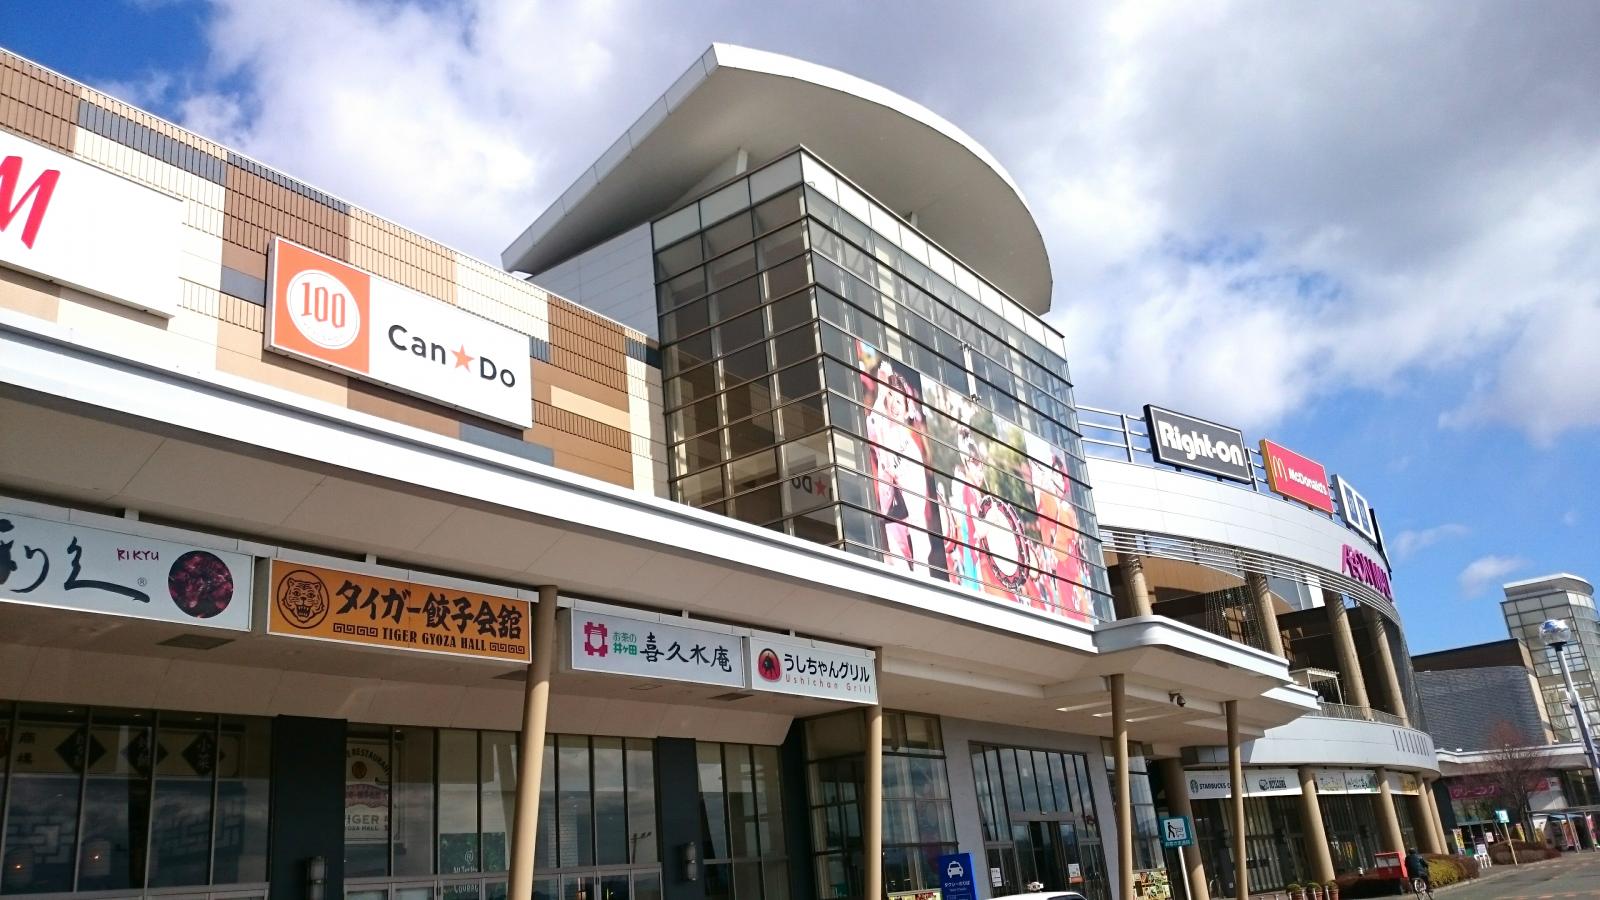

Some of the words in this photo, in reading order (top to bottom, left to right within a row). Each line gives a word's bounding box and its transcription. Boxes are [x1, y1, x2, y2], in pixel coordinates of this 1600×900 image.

[300, 282, 346, 329] 100
[388, 324, 447, 365] Can
[479, 356, 516, 388] Do
[1157, 420, 1244, 466] Right-on
[1288, 467, 1329, 496] McDonald's
[116, 547, 160, 561] RIKYU
[382, 627, 418, 644] TIGER
[421, 632, 457, 648] GYOZA
[460, 637, 487, 652] HALL
[639, 631, 733, 673] 喜久水庵
[784, 653, 870, 683] うしちゃんグリル
[785, 673, 839, 690] Ushichan
